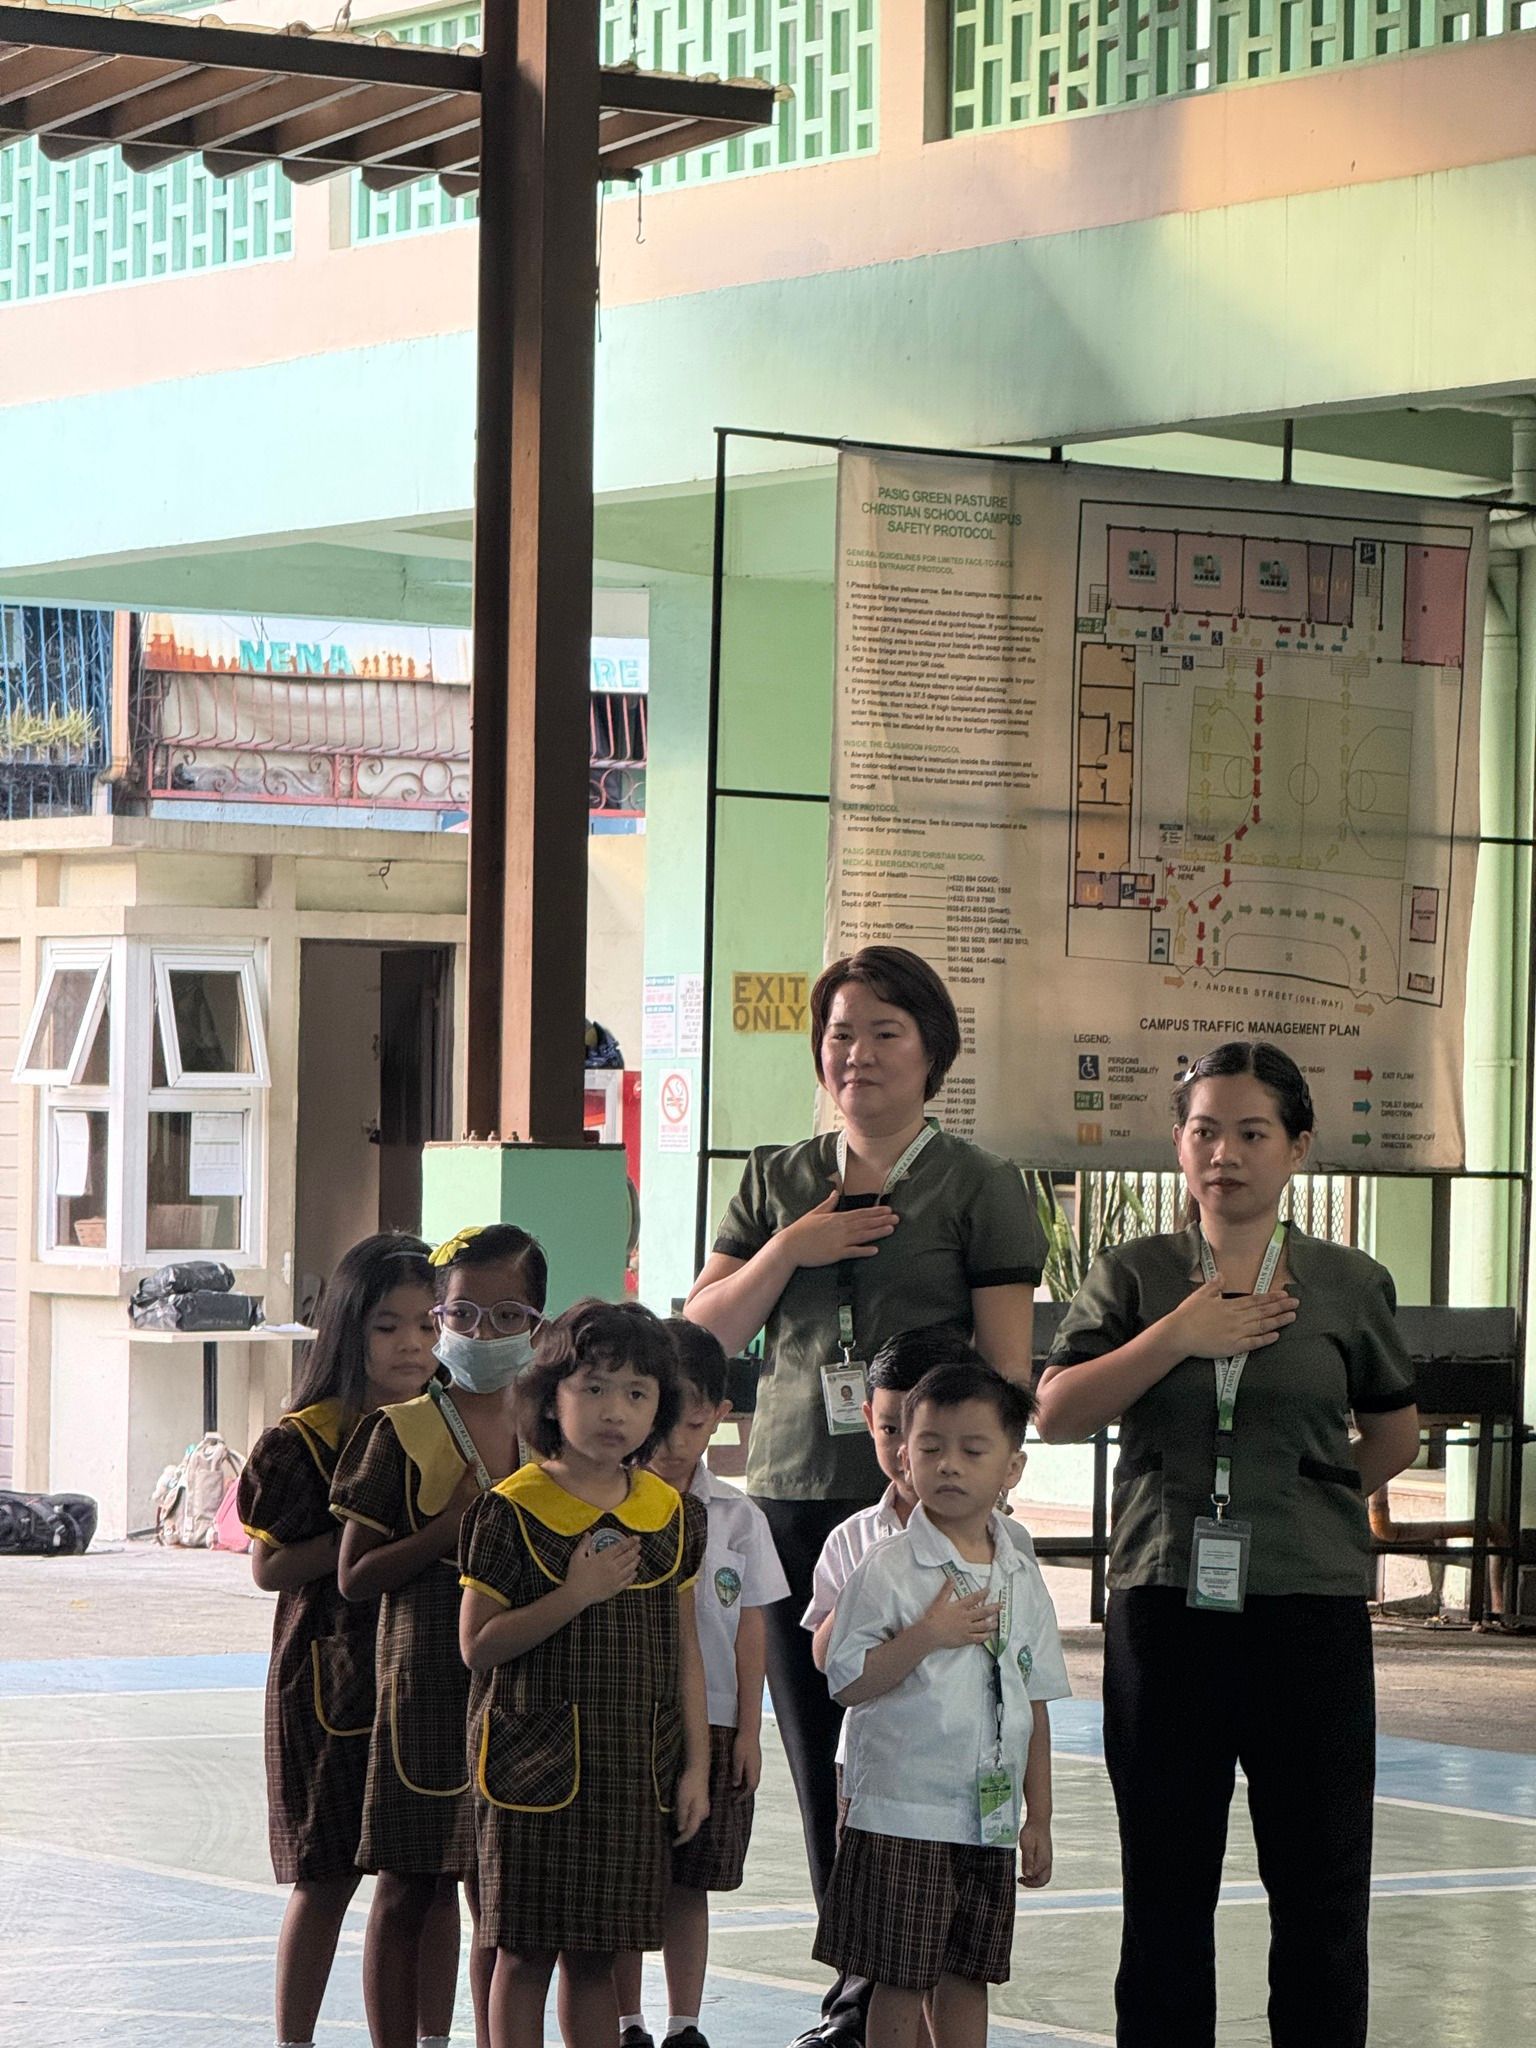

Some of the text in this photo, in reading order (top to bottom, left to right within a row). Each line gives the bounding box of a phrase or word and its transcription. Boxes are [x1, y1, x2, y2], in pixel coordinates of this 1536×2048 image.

[878, 487, 1008, 509] PASIG GREEN PASTURE
[861, 502, 1022, 526] CHRISTIAN SCHOOL CAMPUS
[887, 520, 996, 541] SAFETY PROTOCOL
[846, 559, 954, 575] CLASSES ENTRANCE PROTOCOL
[851, 581, 871, 590] Please
[900, 586, 919, 594] yellow
[964, 591, 987, 599] campus
[868, 604, 882, 612] your
[238, 638, 356, 675] NENA
[843, 803, 899, 813] EXIT PROTOCOL
[1194, 833, 1216, 842] TRIAGE
[865, 848, 891, 856] GREEN
[892, 850, 921, 858] PASTURE
[922, 851, 956, 859] CHRISTIAN
[957, 853, 985, 862] SCHOOL
[843, 859, 873, 867] MEDICAL
[1177, 864, 1206, 873] YOU ARE
[842, 869, 877, 878] Department
[886, 871, 908, 879] Health
[1177, 873, 1194, 881] HERE
[841, 890, 863, 898] Bureau
[872, 891, 907, 899] Quarantine
[840, 921, 914, 930] Pasig City Health Office
[840, 931, 858, 940] Pasig
[859, 931, 871, 940] City
[735, 975, 806, 1003] EXIT
[1206, 982, 1249, 996] ANDRES
[1254, 988, 1293, 1001] STREET
[733, 1004, 808, 1031] ONLY
[1139, 1017, 1361, 1038] CAMPUS TRAFFIC MANAGEMENT PLAN
[1108, 1056, 1139, 1065] PERSONS
[1108, 1065, 1159, 1075] WITH DISABILITY
[1108, 1075, 1134, 1083] ACCESS
[1382, 1072, 1414, 1080] EXIT FLOW
[1109, 1093, 1148, 1102] EMERGENCY
[1381, 1109, 1413, 1118] DIRECTION
[1109, 1129, 1131, 1137] TOILET
